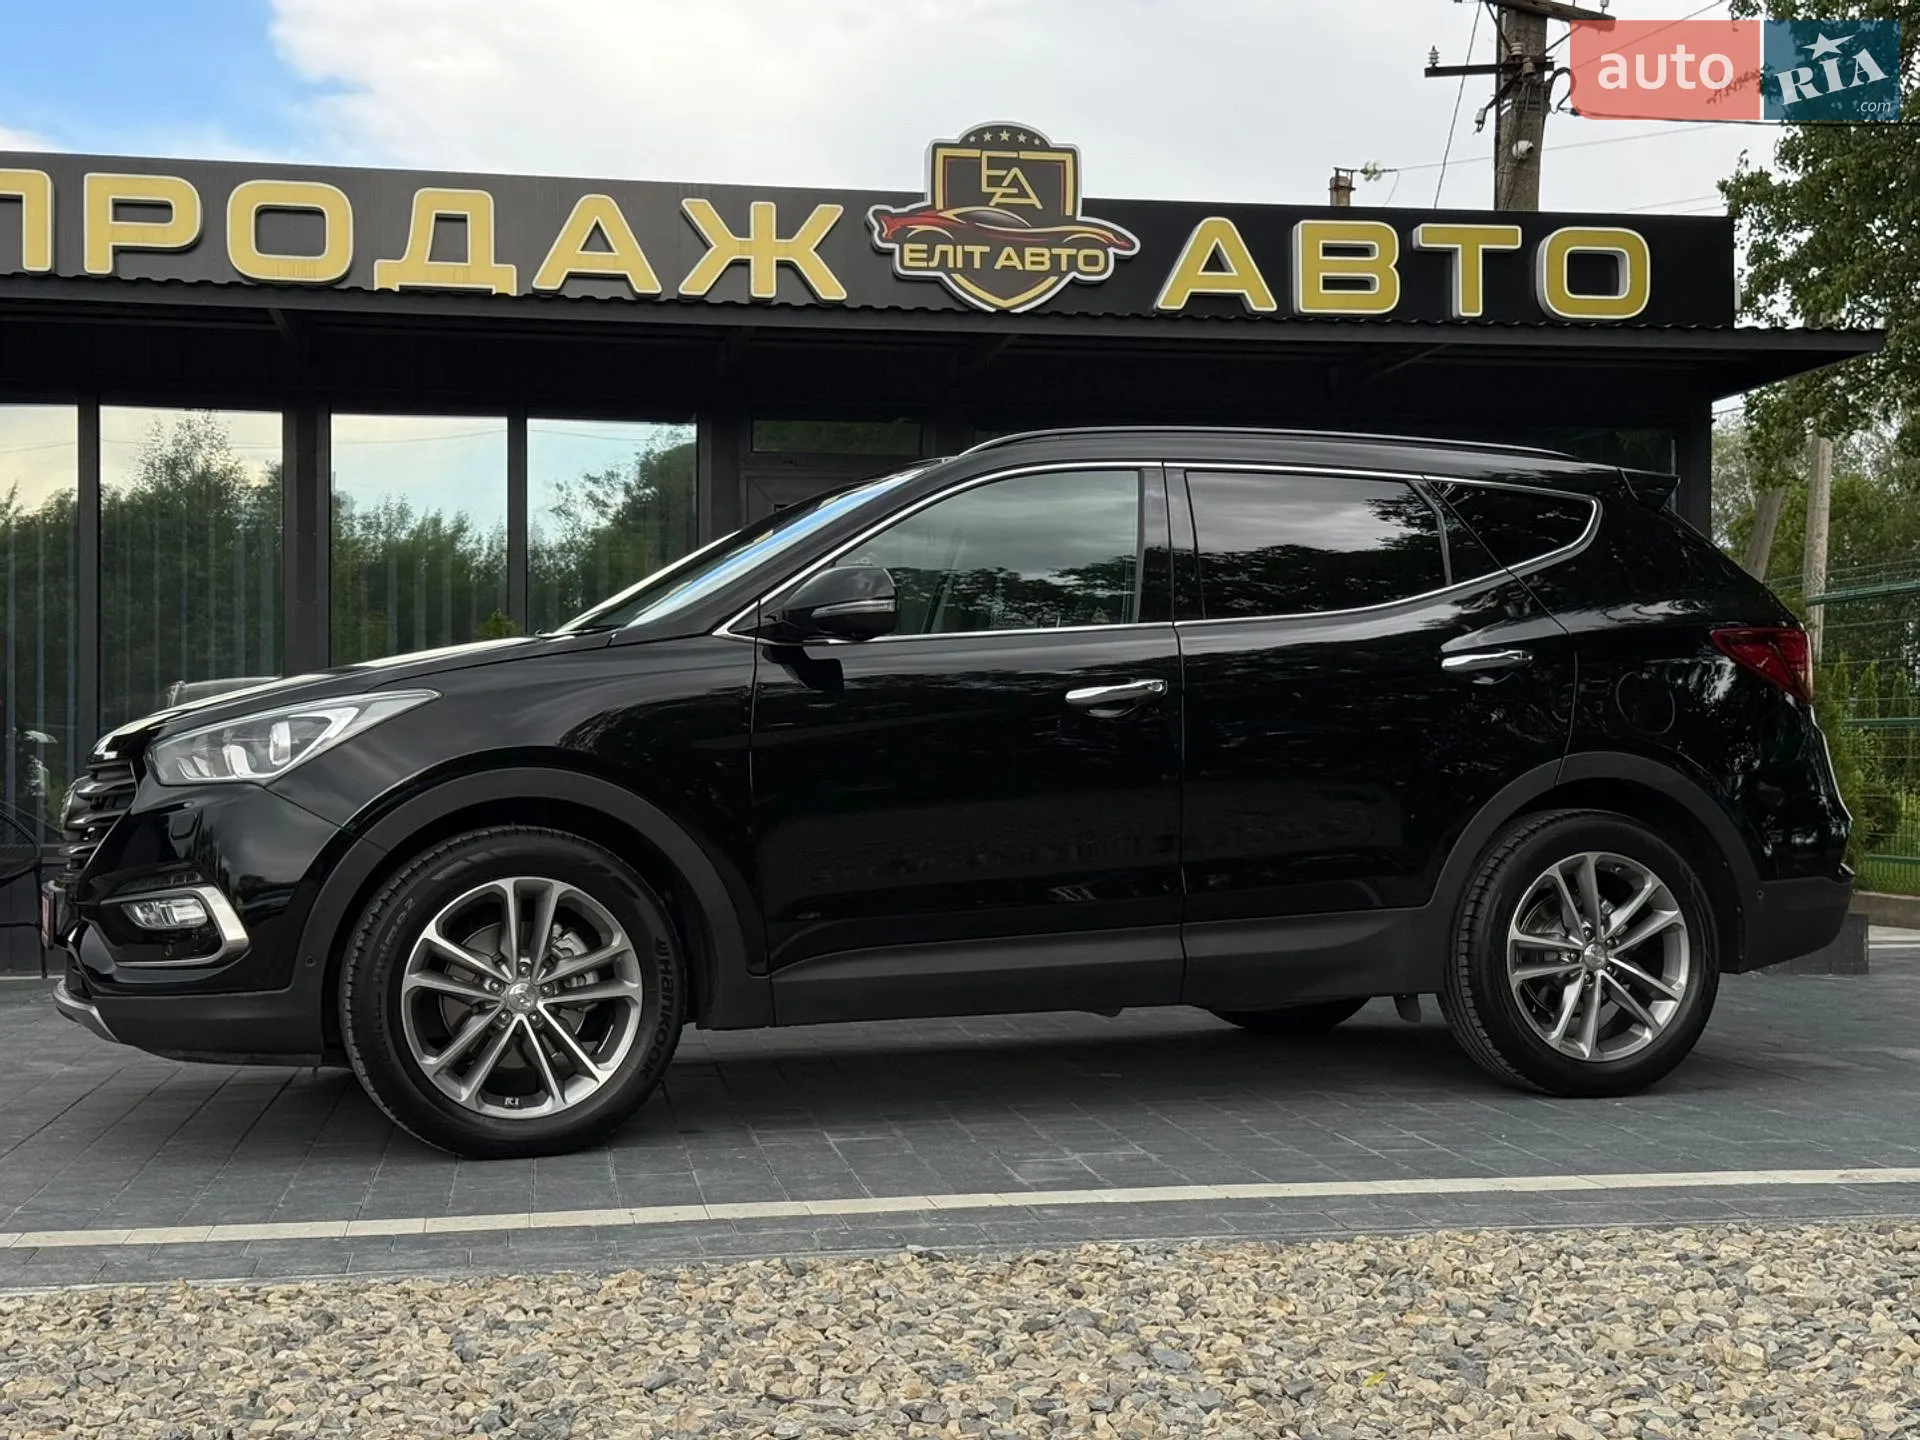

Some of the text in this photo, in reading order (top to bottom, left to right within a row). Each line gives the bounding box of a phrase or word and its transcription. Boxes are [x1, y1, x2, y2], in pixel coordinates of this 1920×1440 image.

[902, 243, 1106, 273] ЕЛІТ АВТО
[1155, 216, 1652, 322] АВТО
